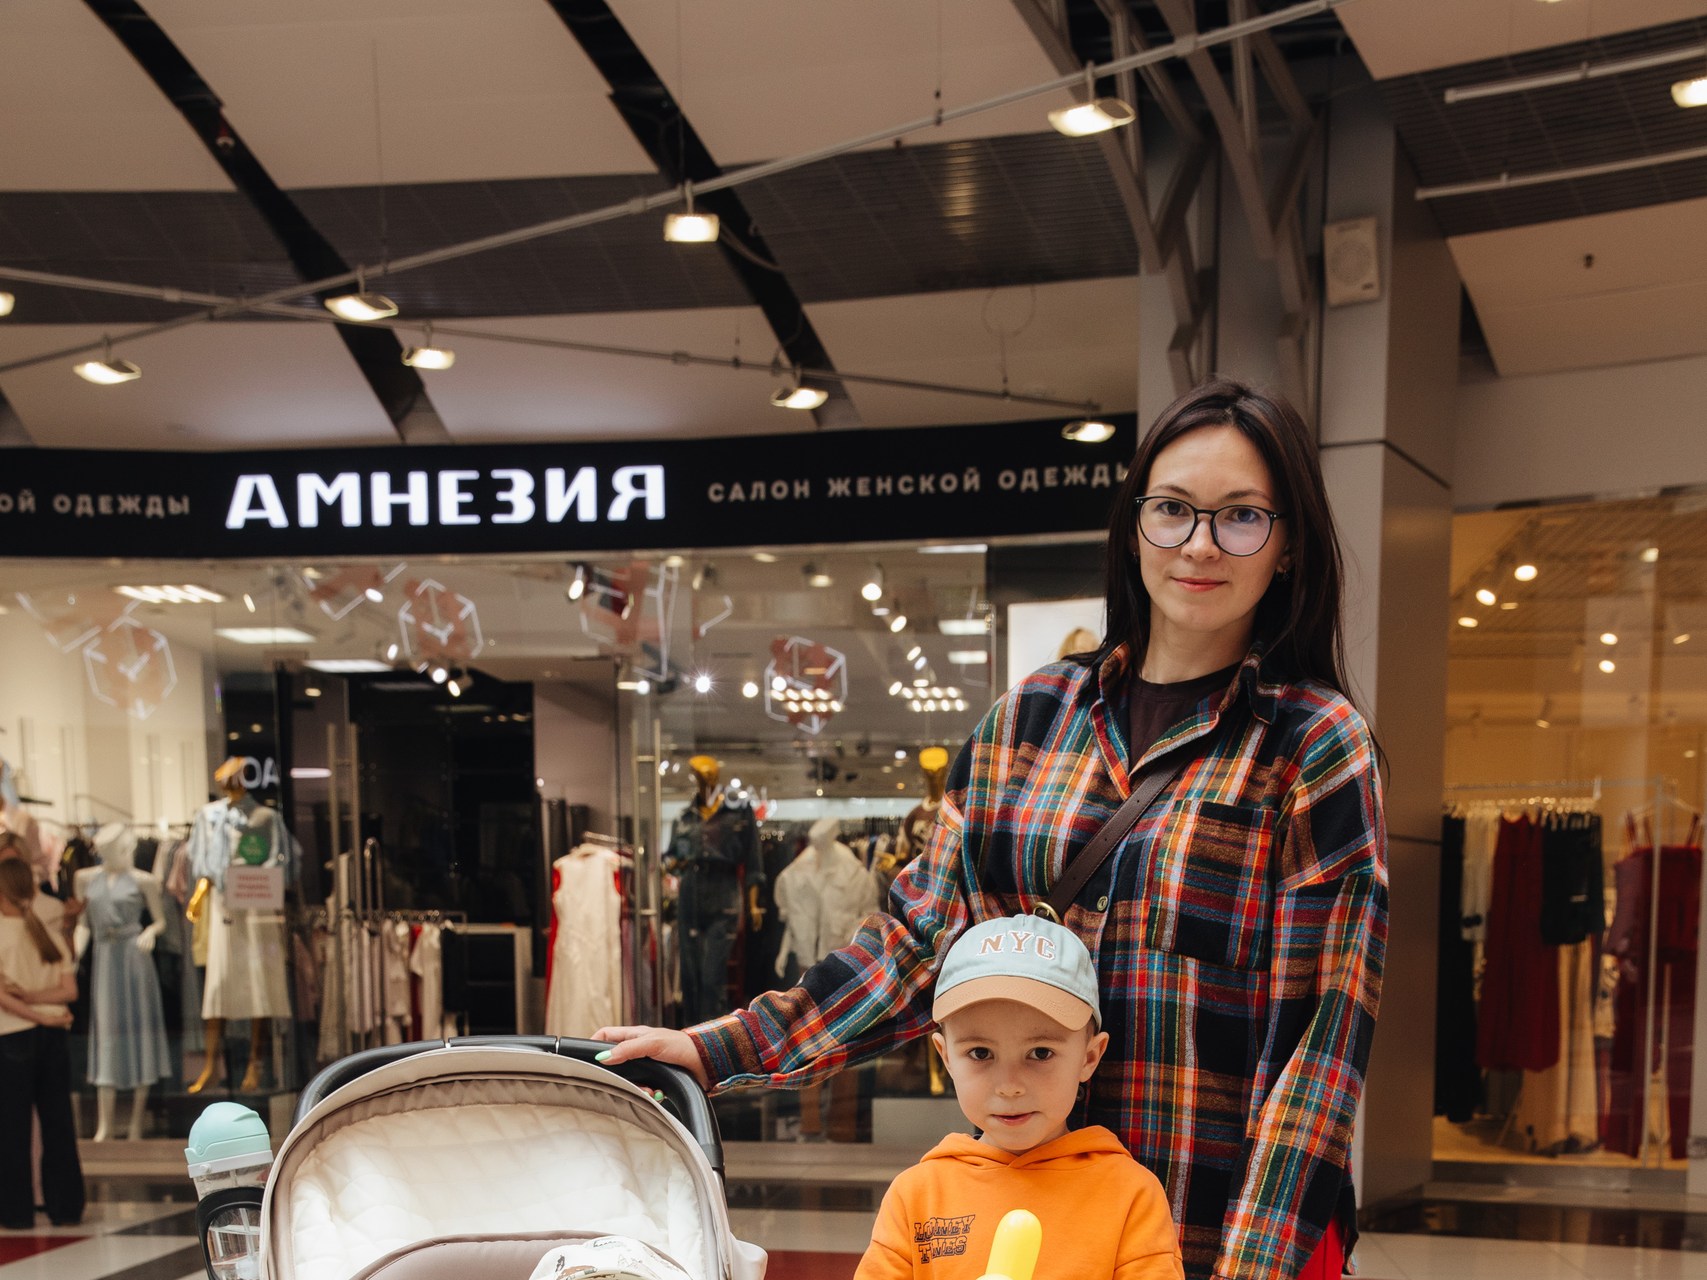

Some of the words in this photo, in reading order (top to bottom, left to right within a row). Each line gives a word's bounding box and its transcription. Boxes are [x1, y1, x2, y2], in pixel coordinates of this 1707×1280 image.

[225, 464, 666, 530] АМНЕЗИЯ
[707, 478, 811, 503] САЛОН
[828, 466, 982, 498] ЖЕНСКОЙ
[52, 493, 190, 519] ОДЕЖДЫ
[976, 930, 1056, 960] NYC
[918, 1235, 968, 1264] TNES
